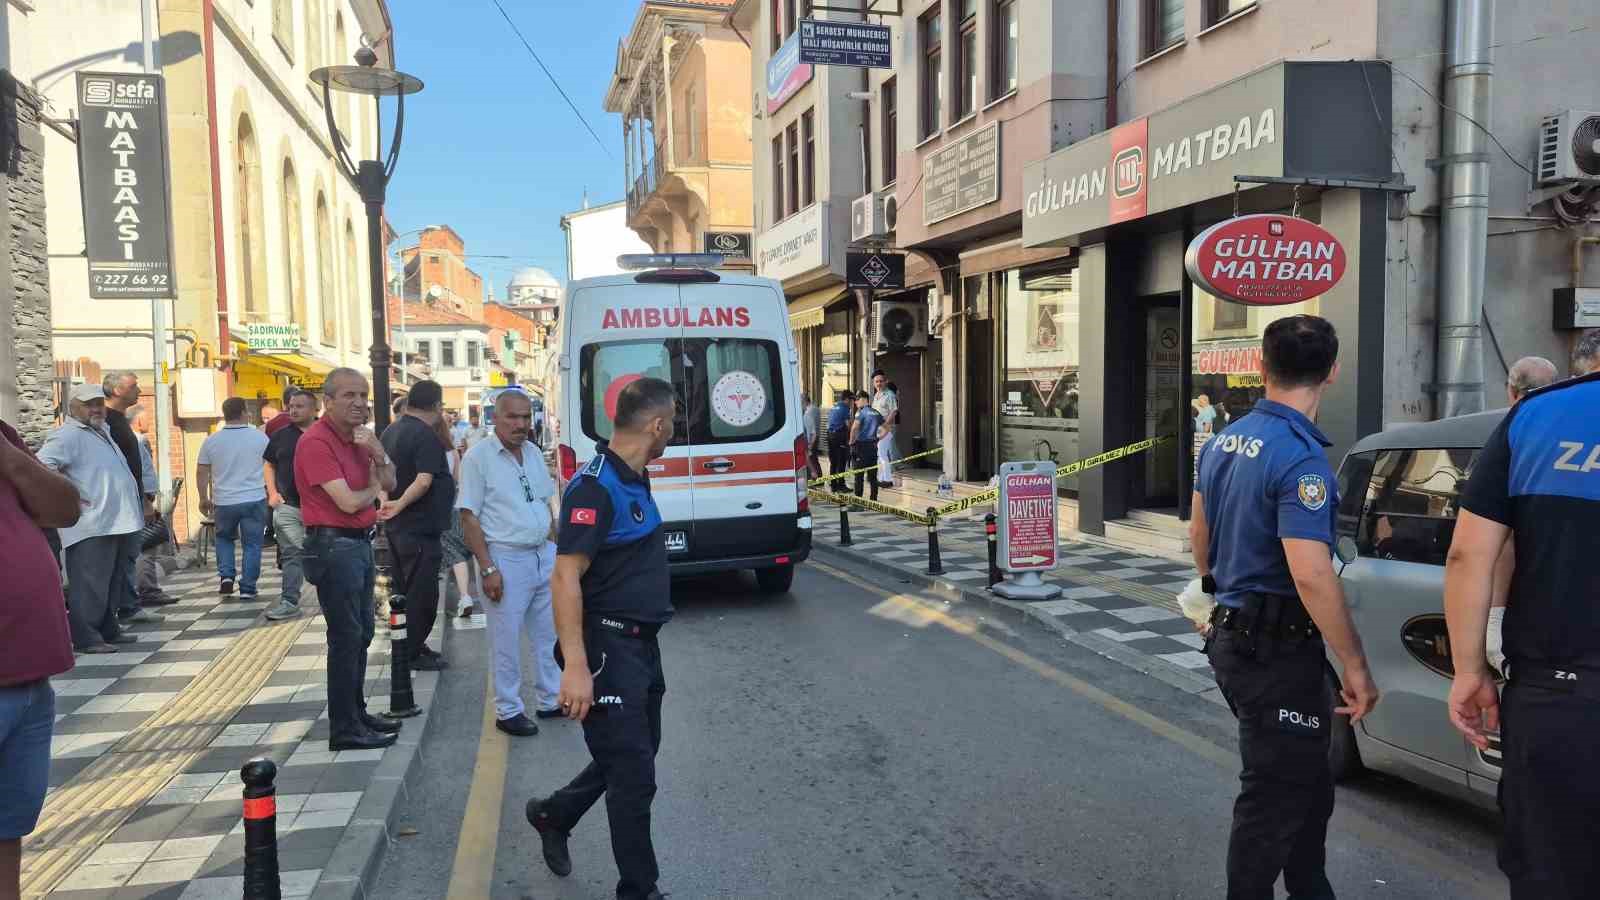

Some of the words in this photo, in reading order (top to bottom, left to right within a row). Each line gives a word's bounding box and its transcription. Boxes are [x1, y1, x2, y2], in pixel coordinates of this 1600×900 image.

[116, 80, 154, 98] sefa
[1152, 108, 1276, 181] MATBAA
[104, 111, 141, 260] MATBAASI
[1026, 167, 1107, 218] GÜLHAN
[1215, 234, 1336, 260] GÜLHAN
[103, 274, 128, 285] 227
[131, 274, 148, 285] 66
[151, 274, 168, 285] 92
[1211, 261, 1334, 281] MATBAA
[602, 306, 751, 330] AMBULANS
[248, 338, 278, 348] ERKEK
[282, 338, 299, 348] WC
